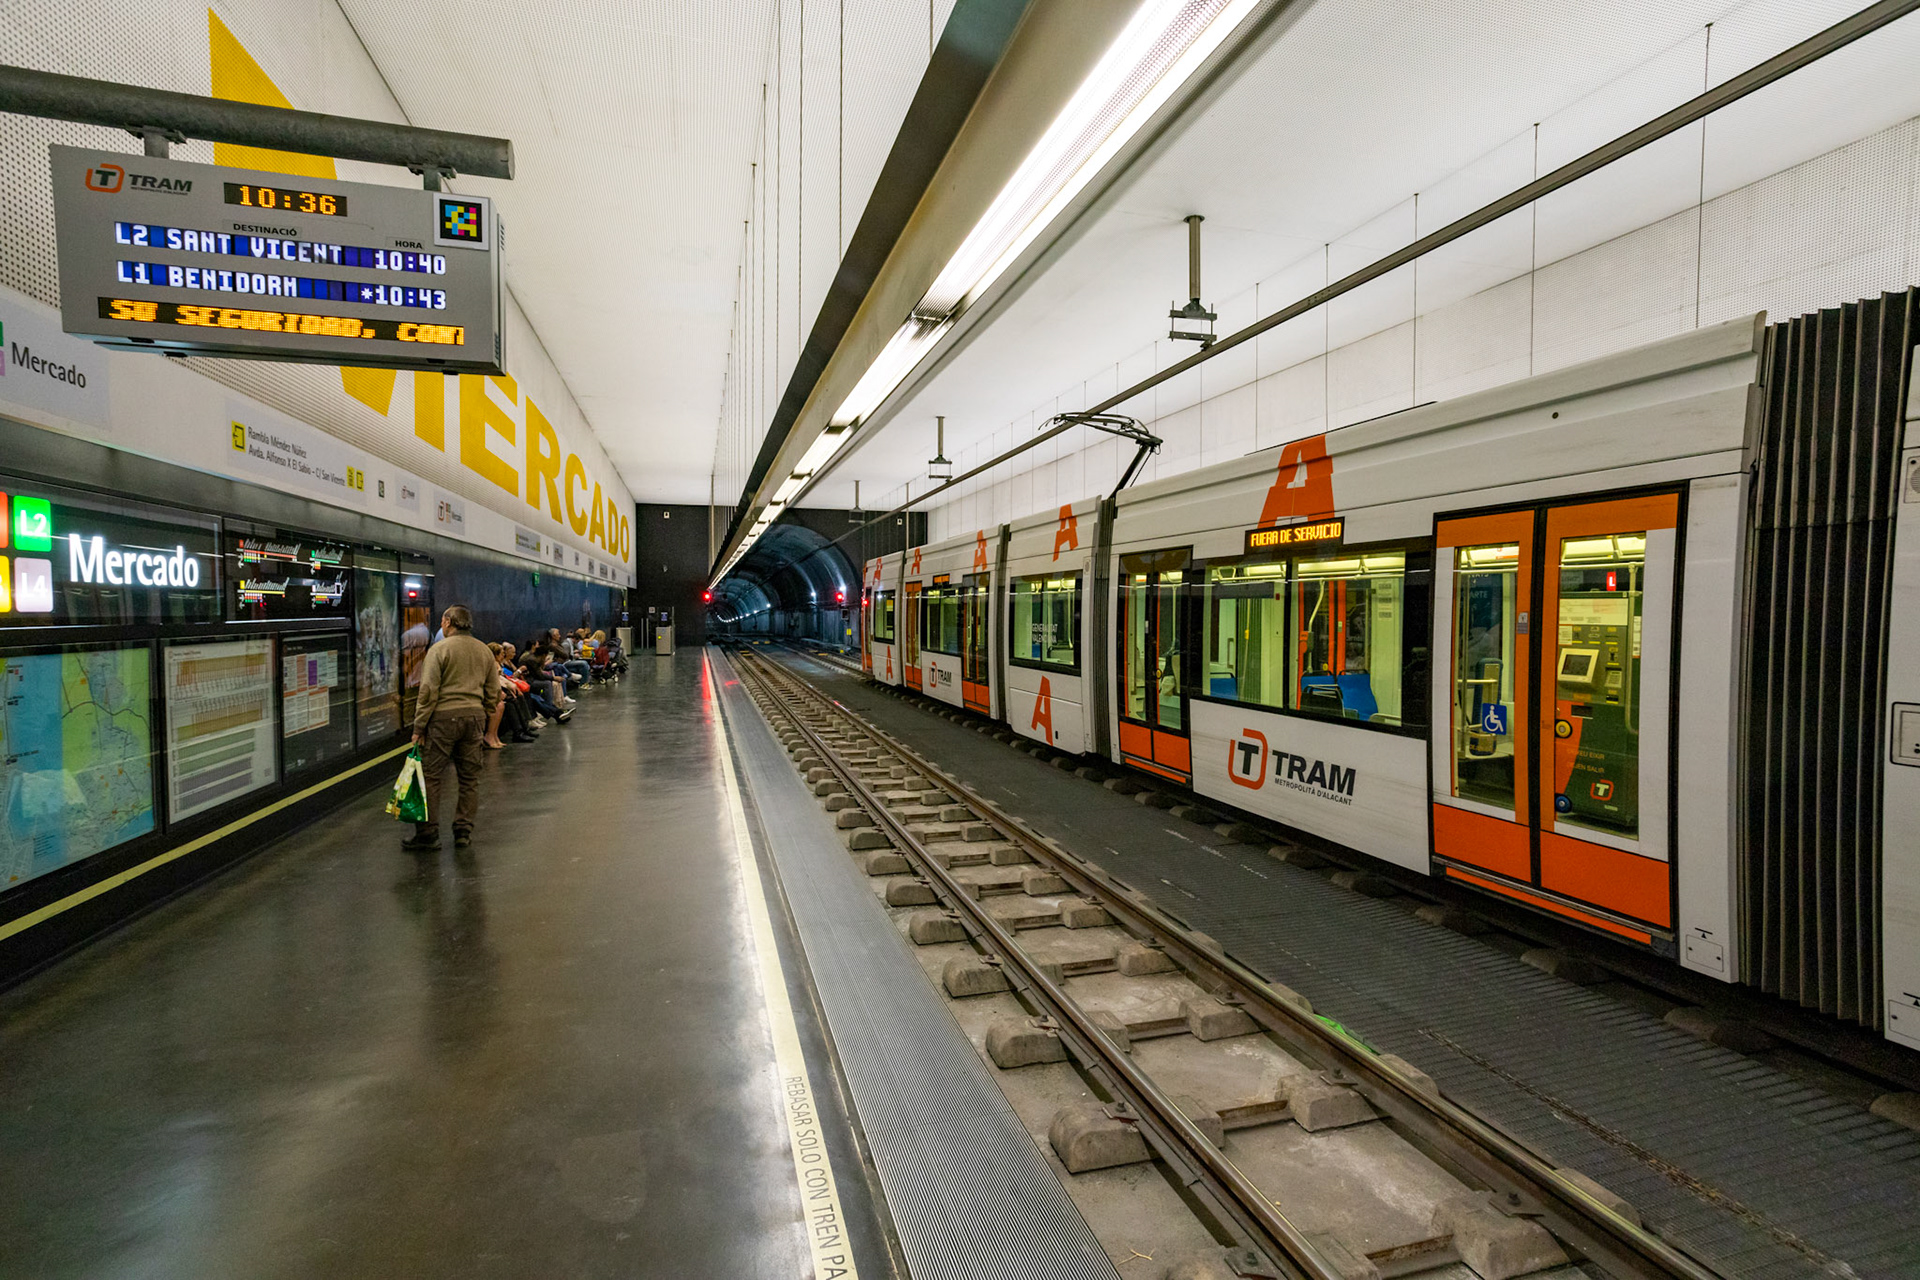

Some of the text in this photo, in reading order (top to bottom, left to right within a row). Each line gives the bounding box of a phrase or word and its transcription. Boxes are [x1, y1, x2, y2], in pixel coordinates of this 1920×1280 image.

[128, 173, 192, 192] TRAM
[239, 185, 337, 215] 10:36
[233, 223, 297, 237] DESTINACIÓ
[395, 240, 423, 249] HORA
[115, 222, 447, 275] L2 SANT VICENT 10:40
[117, 260, 151, 285] L1
[169, 267, 298, 298] BENIDORM
[11, 341, 87, 389] Mercado
[247, 426, 307, 459] Rambla Méndez Núñez
[248, 444, 265, 460] Avda.
[266, 449, 287, 467] Alfonso
[298, 462, 311, 475] Sabio
[20, 509, 47, 537] L2
[1250, 521, 1342, 548] FUERA DE SERVICIO
[69, 533, 199, 588] Mercado
[21, 572, 48, 598] L4
[1271, 749, 1357, 797] TRAM
[1274, 777, 1353, 806] METROPOLITÀ D'ALACANT
[785, 1076, 813, 1127] REBASAR
[796, 1129, 821, 1164] SOLO
[804, 1168, 831, 1200] CON
[812, 1203, 843, 1249] TREN
